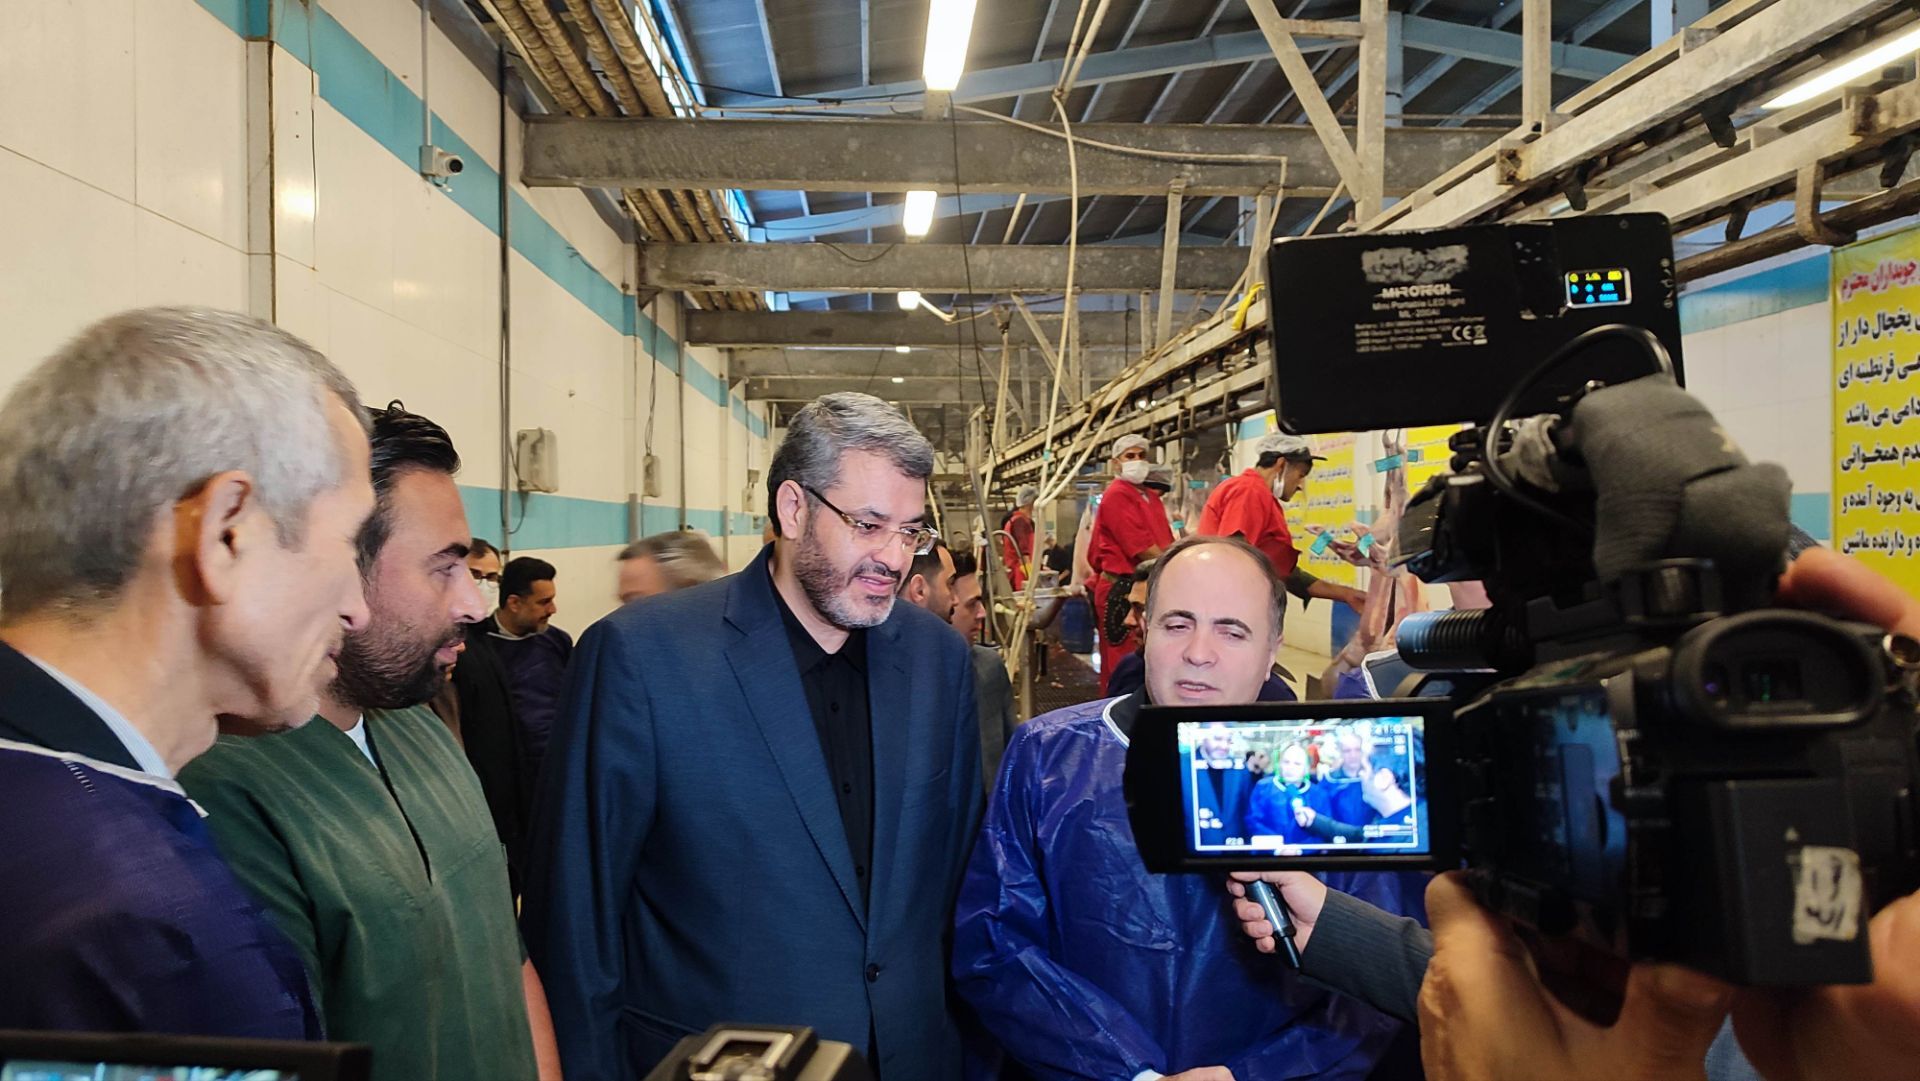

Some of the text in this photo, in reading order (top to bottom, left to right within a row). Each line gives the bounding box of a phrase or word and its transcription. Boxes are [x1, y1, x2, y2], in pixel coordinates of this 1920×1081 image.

[1382, 283, 1452, 299] MIROTECH
[1428, 298, 1446, 307] LED
[1838, 319, 1849, 348] از
[1851, 316, 1869, 345] دار
[1846, 402, 1870, 427] باشد
[1872, 407, 1889, 427] می
[1841, 441, 1899, 471] همخوانی
[1876, 490, 1901, 514] وجود
